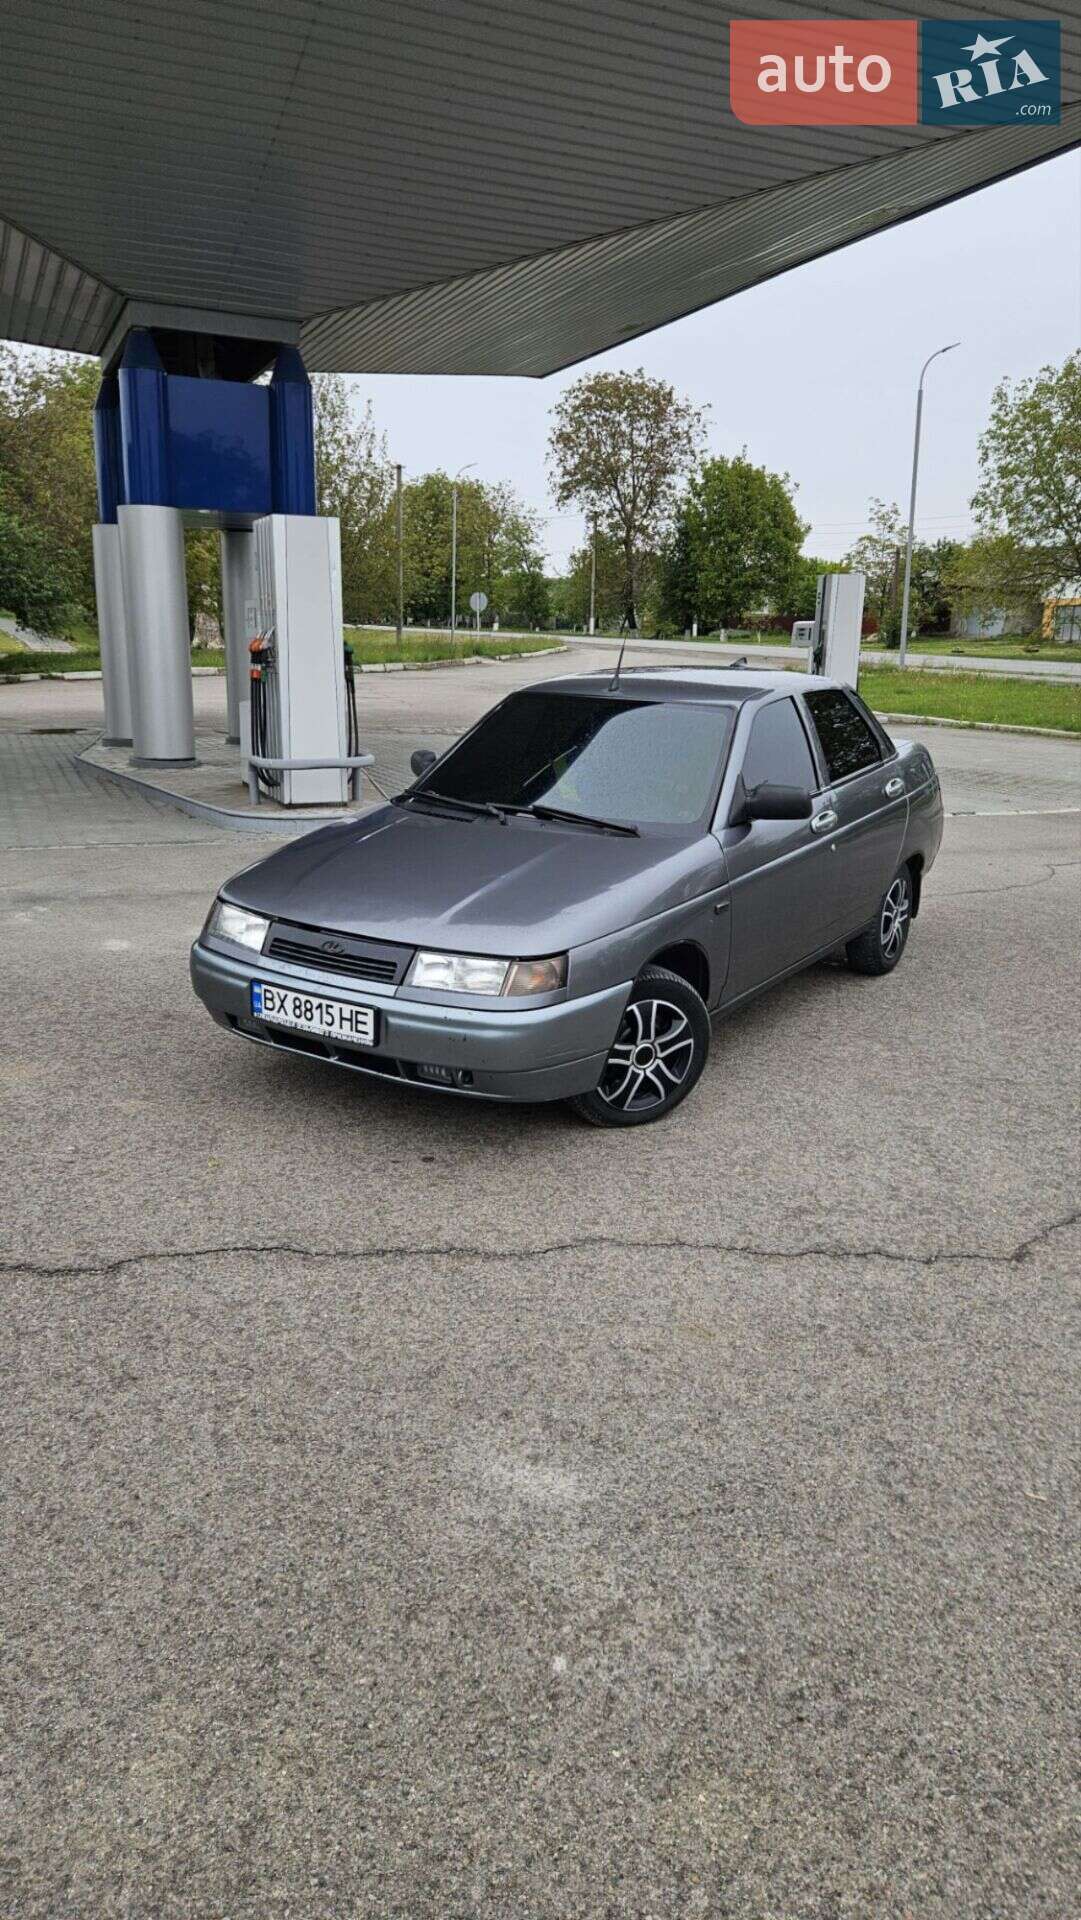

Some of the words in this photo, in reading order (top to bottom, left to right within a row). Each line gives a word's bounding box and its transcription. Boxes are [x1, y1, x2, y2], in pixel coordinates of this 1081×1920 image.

[263, 988, 288, 1016] BX
[292, 996, 335, 1027] 8815
[339, 1007, 369, 1036] HE
